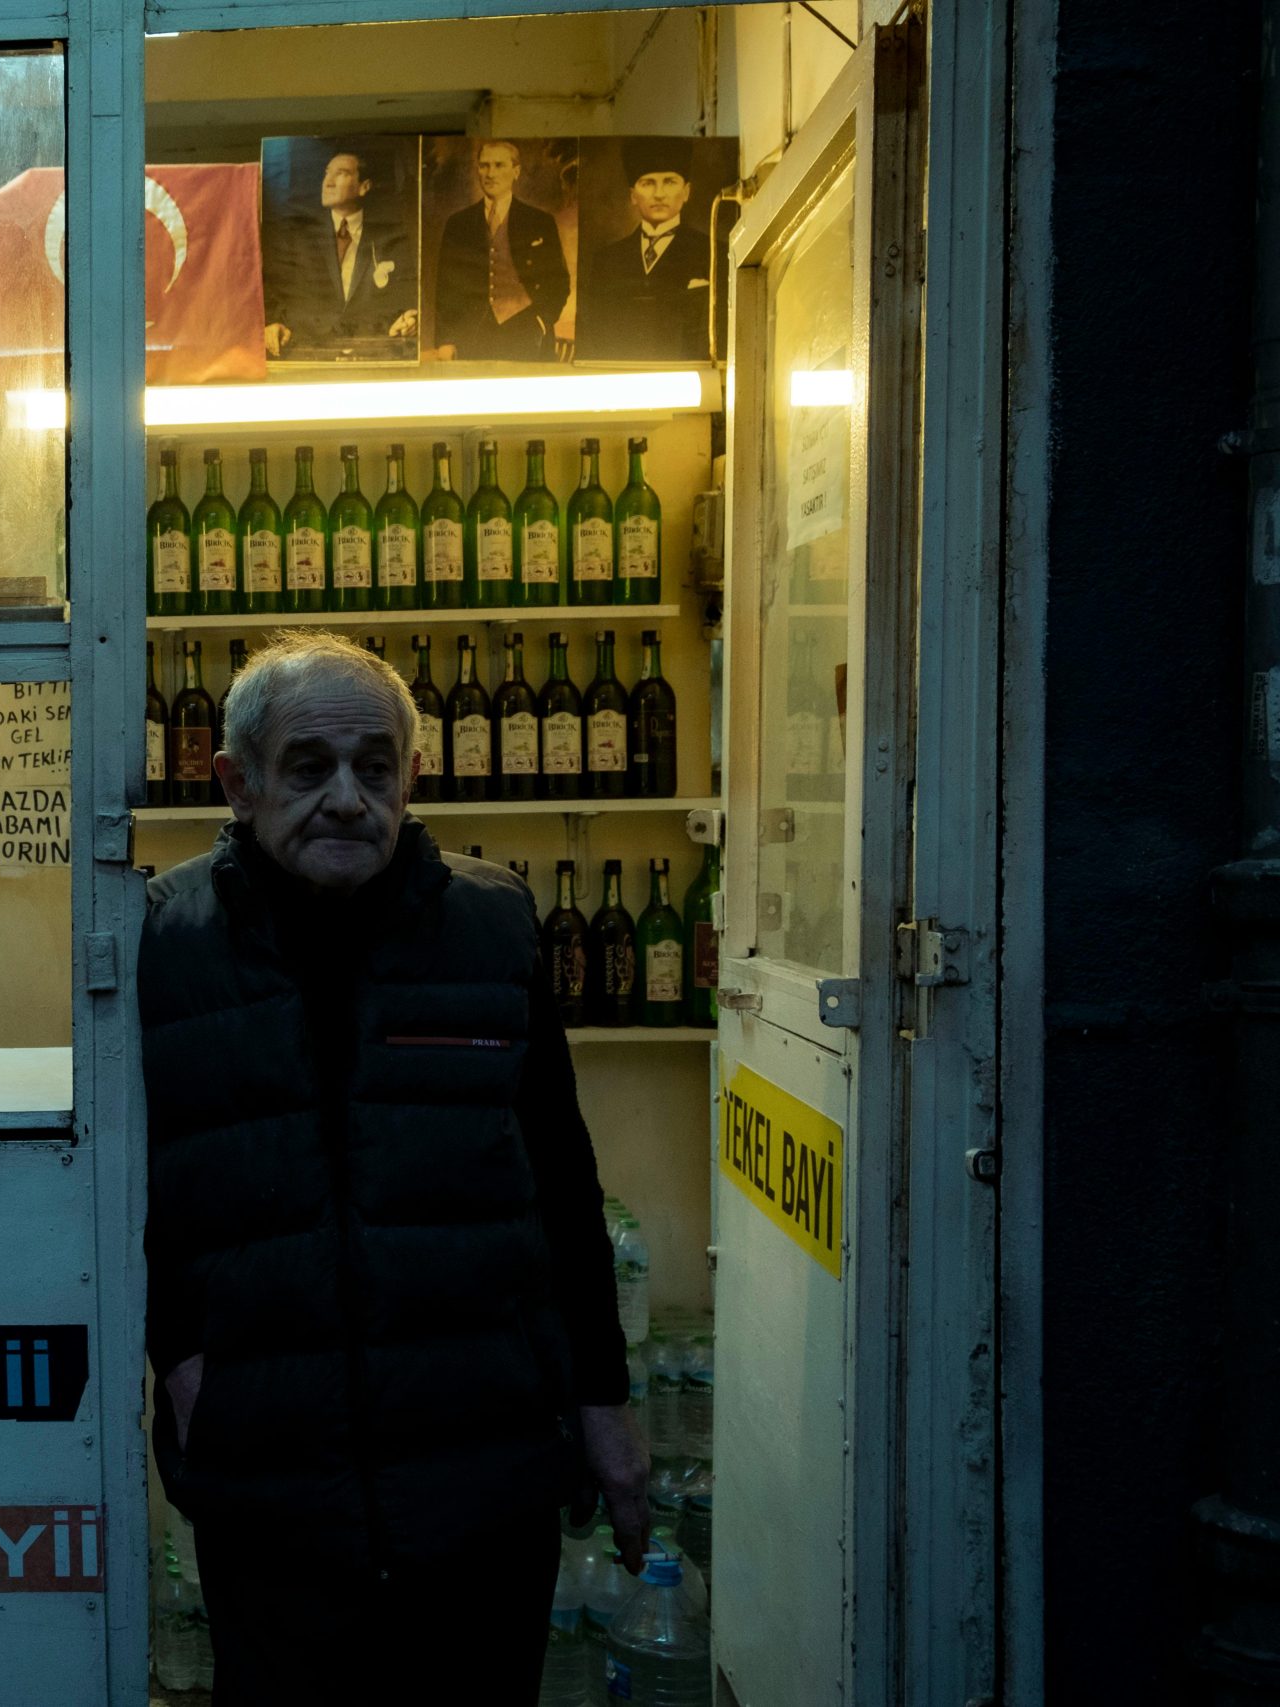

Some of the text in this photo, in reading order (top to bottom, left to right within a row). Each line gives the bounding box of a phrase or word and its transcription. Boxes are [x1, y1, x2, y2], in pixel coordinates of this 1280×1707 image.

[10, 727, 44, 744] GEL
[723, 1086, 835, 1252] TEKEL BAYİ
